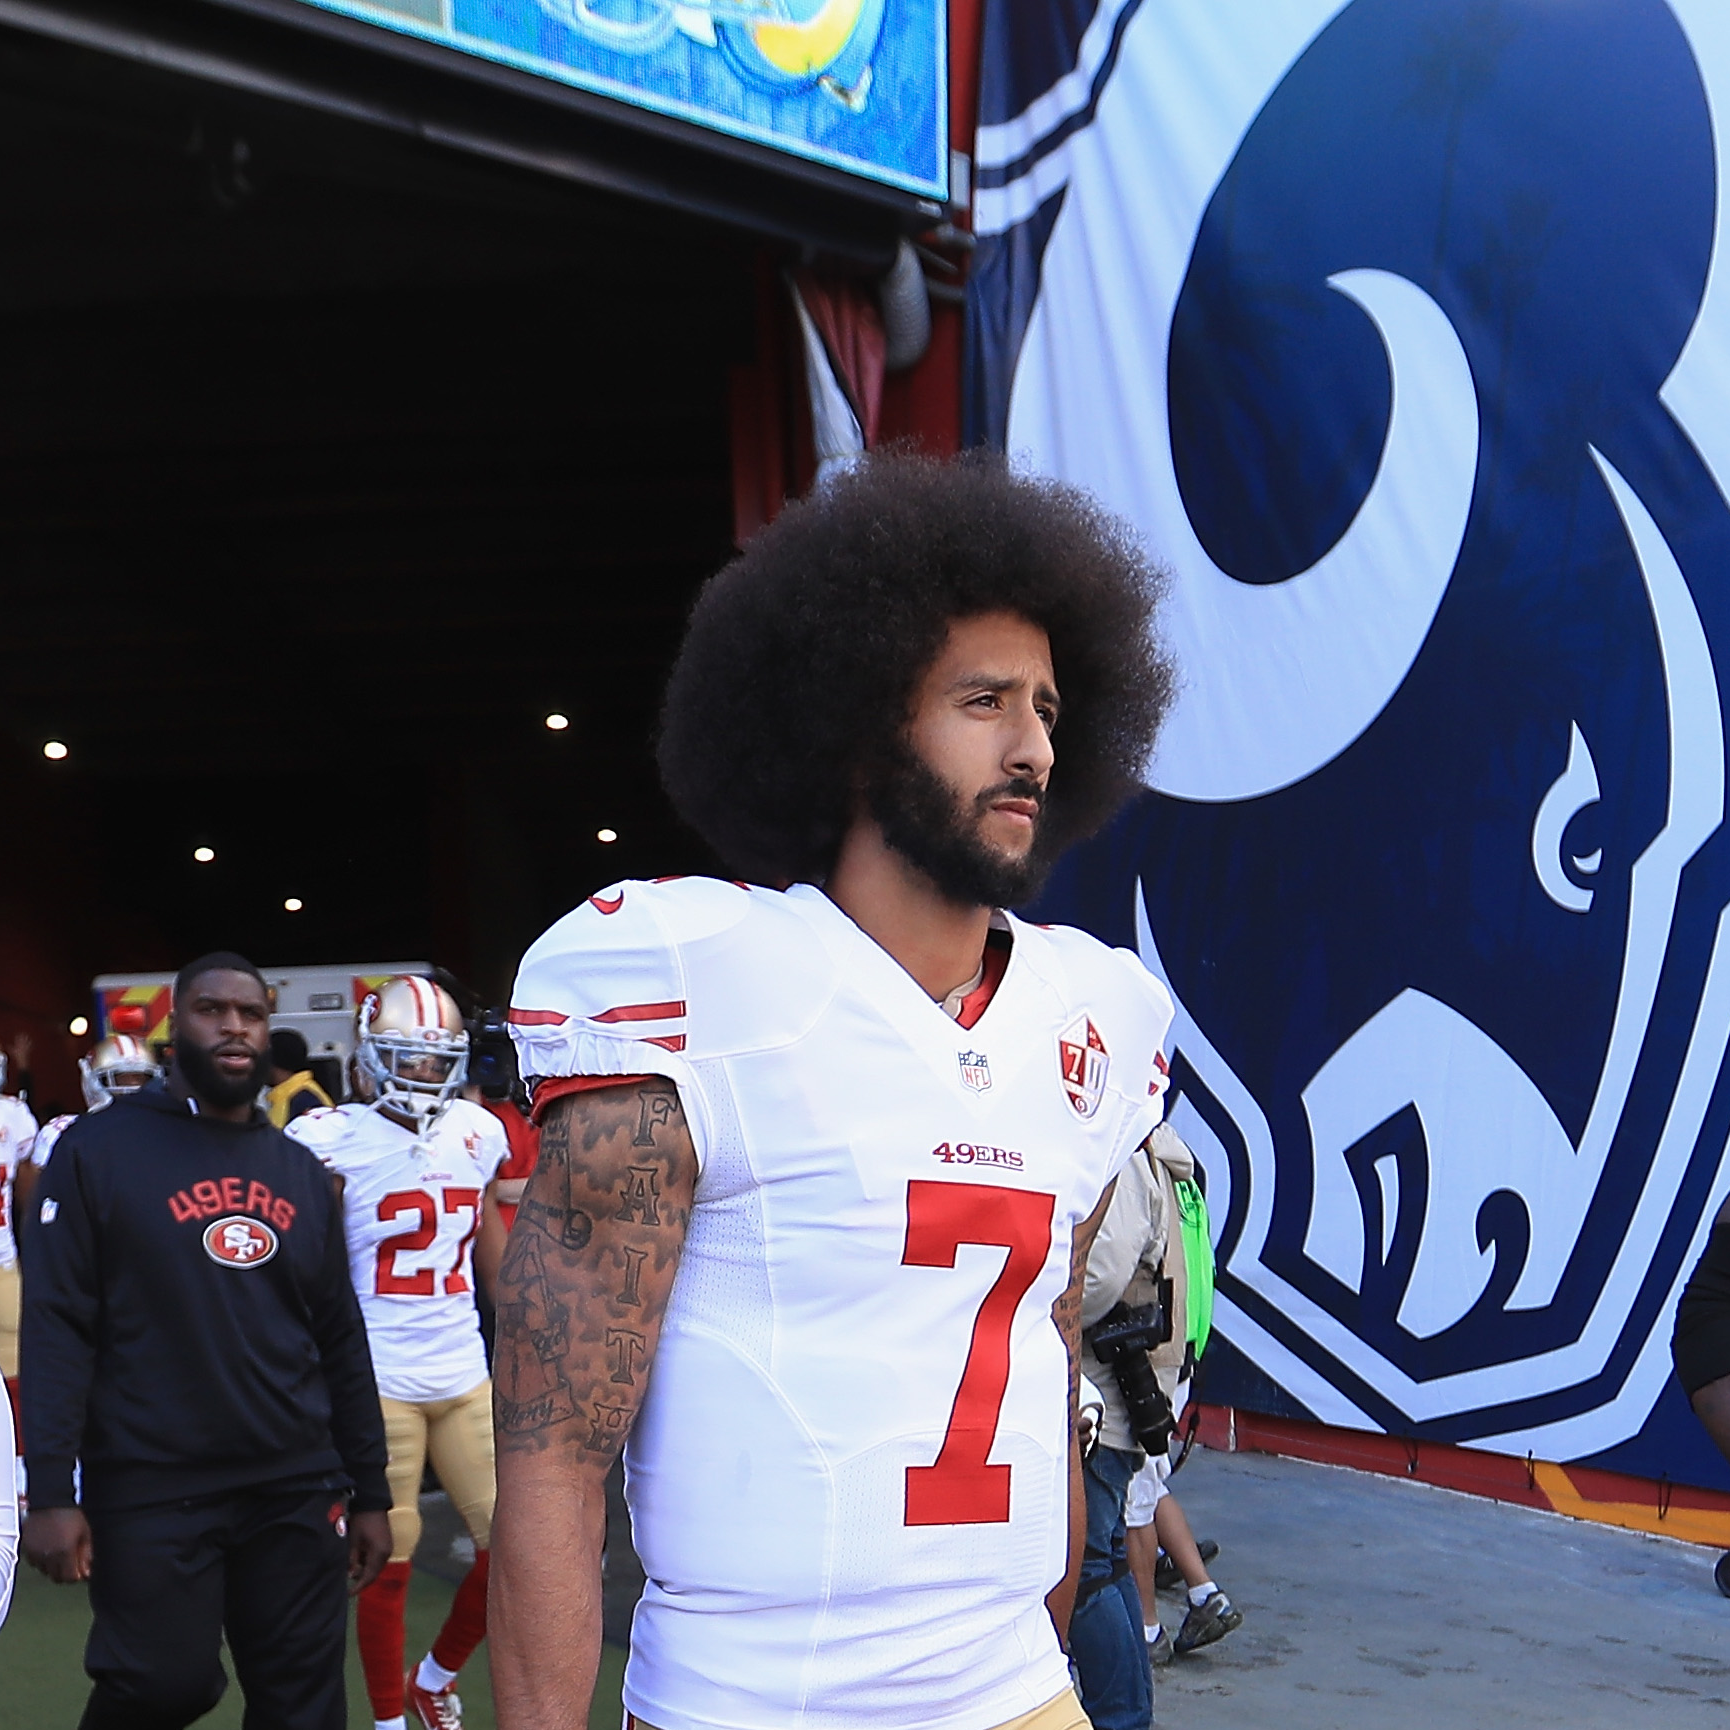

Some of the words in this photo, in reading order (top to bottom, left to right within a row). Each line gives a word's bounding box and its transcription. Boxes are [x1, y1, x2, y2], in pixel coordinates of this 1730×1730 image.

[964, 1067, 990, 1087] NFL
[932, 1142, 1024, 1167] 49ERS
[168, 1177, 297, 1231] 49ERS
[376, 1188, 481, 1295] 27
[901, 1179, 1057, 1527] 7
